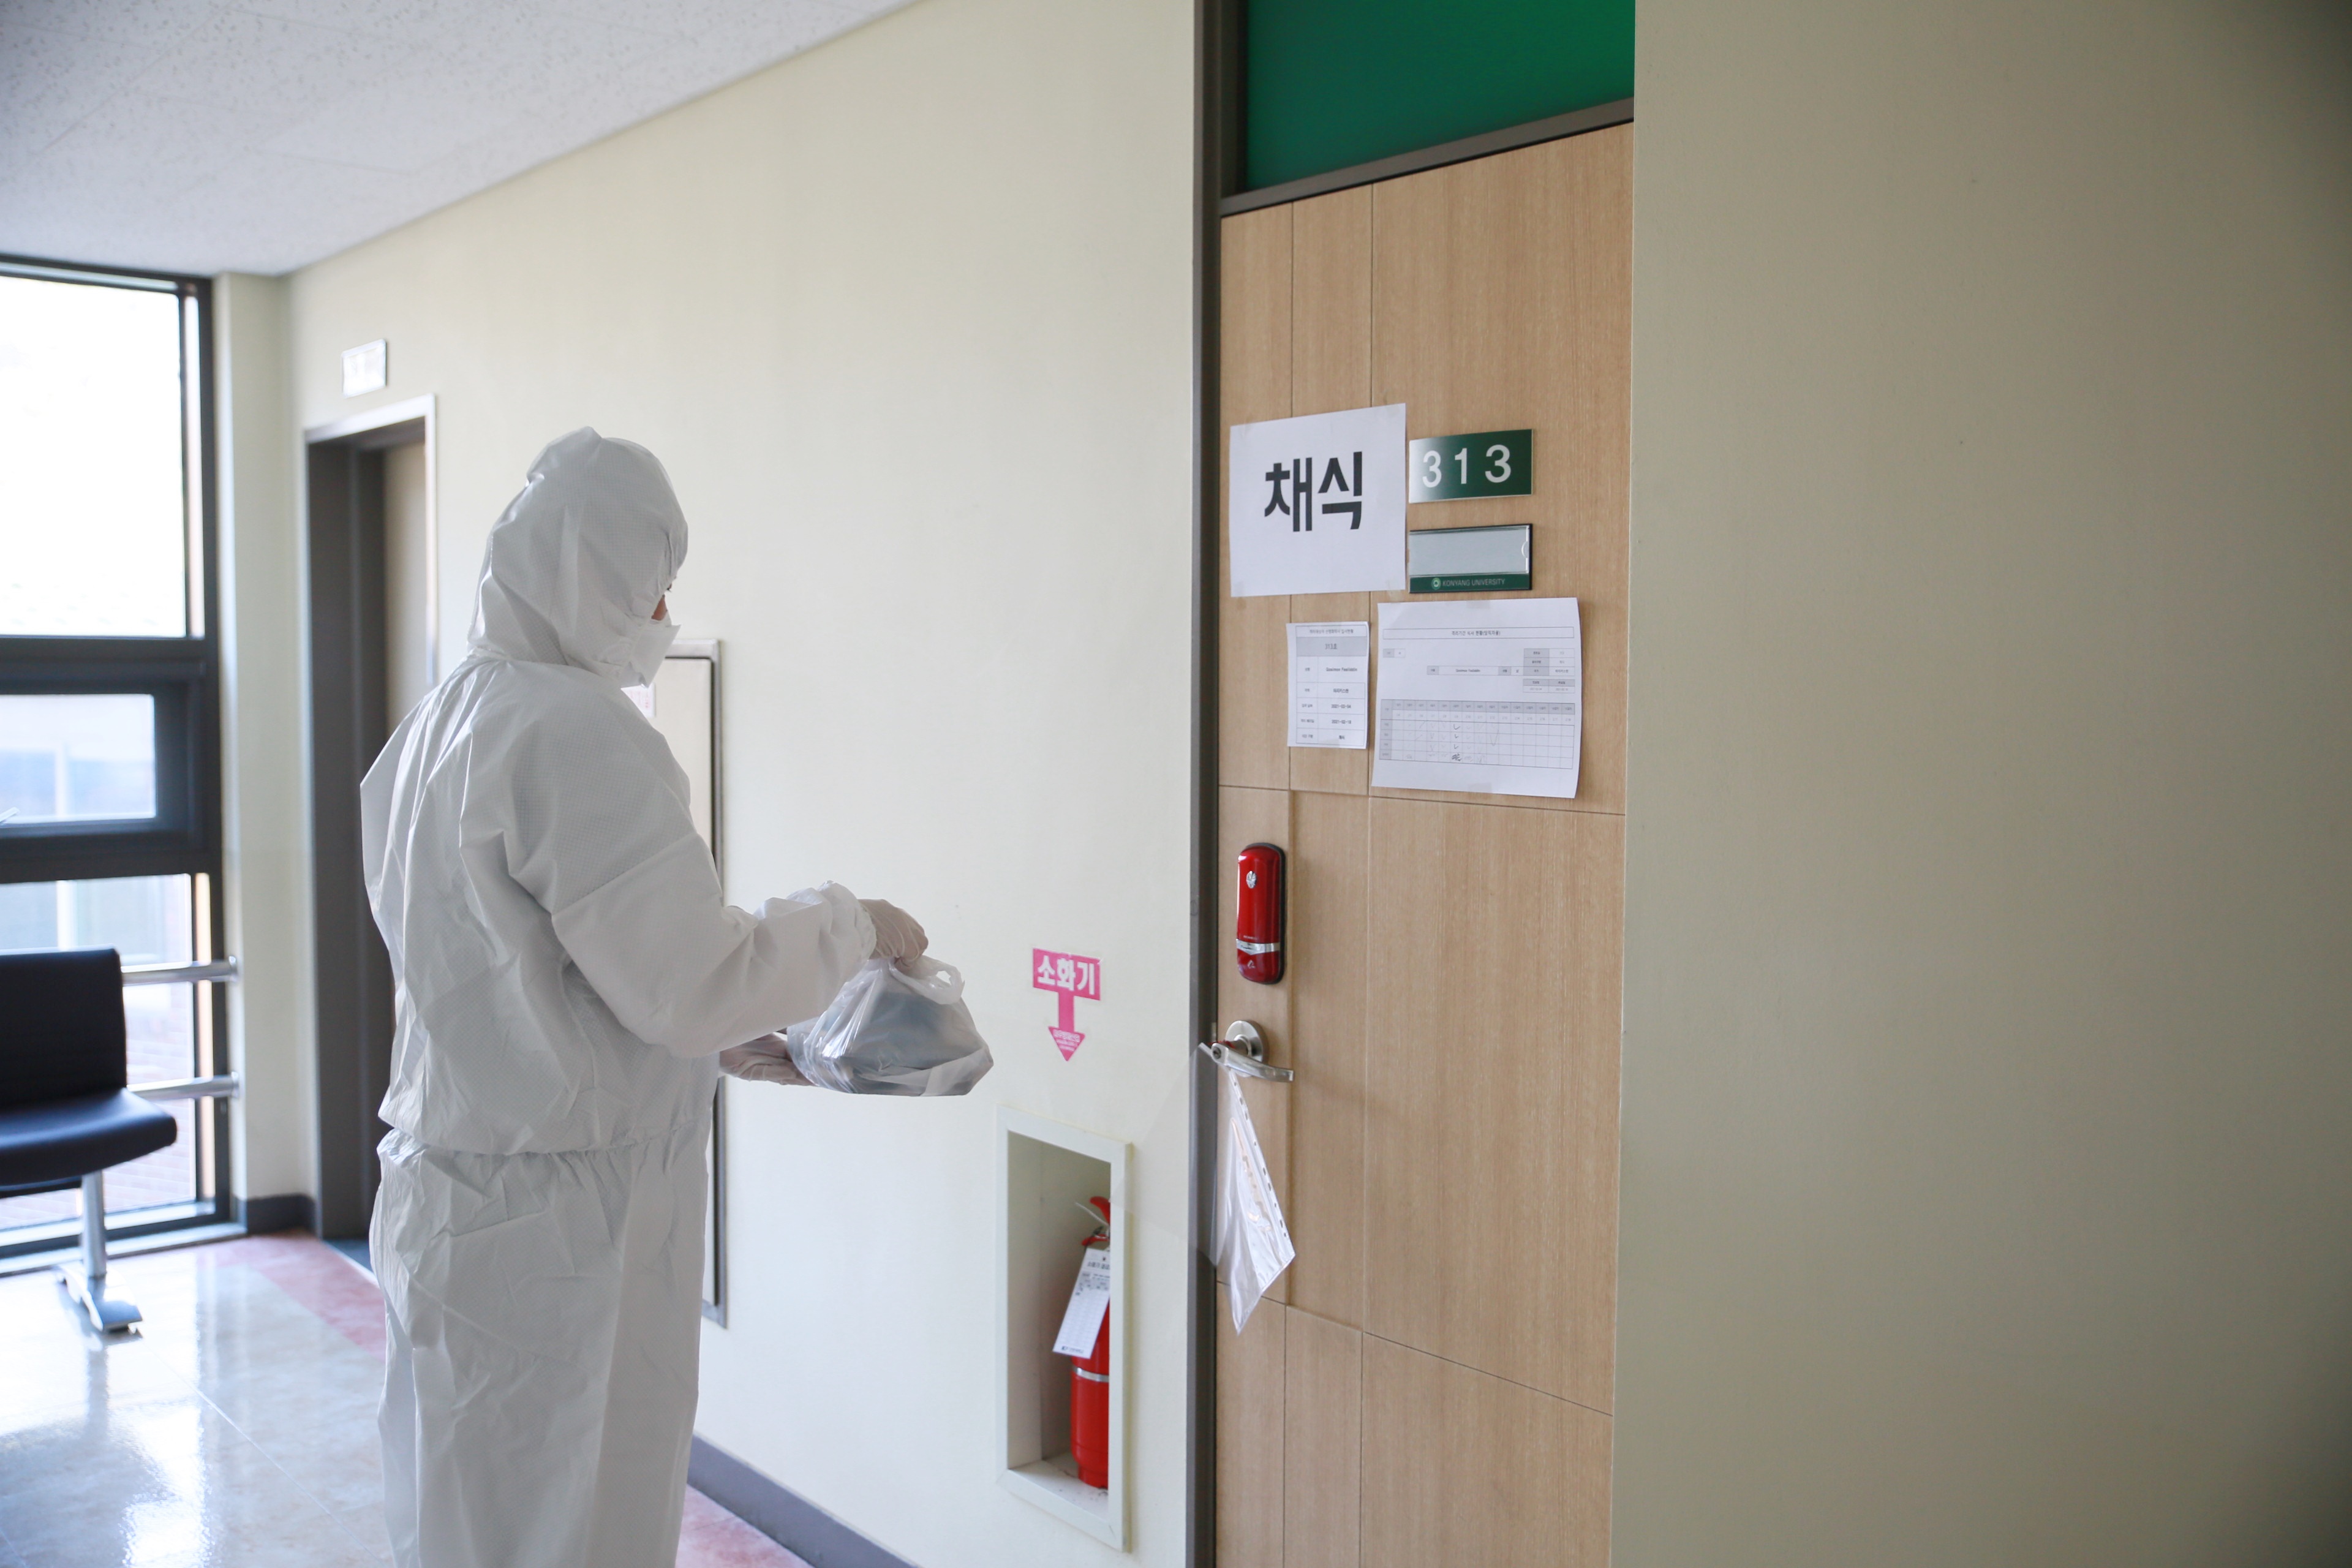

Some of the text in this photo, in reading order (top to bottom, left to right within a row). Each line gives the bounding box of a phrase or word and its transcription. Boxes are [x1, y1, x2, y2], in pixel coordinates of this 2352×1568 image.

[1422, 444, 1512, 488] 313
[1264, 451, 1363, 532] 채식
[1037, 955, 1095, 996] 소화기
